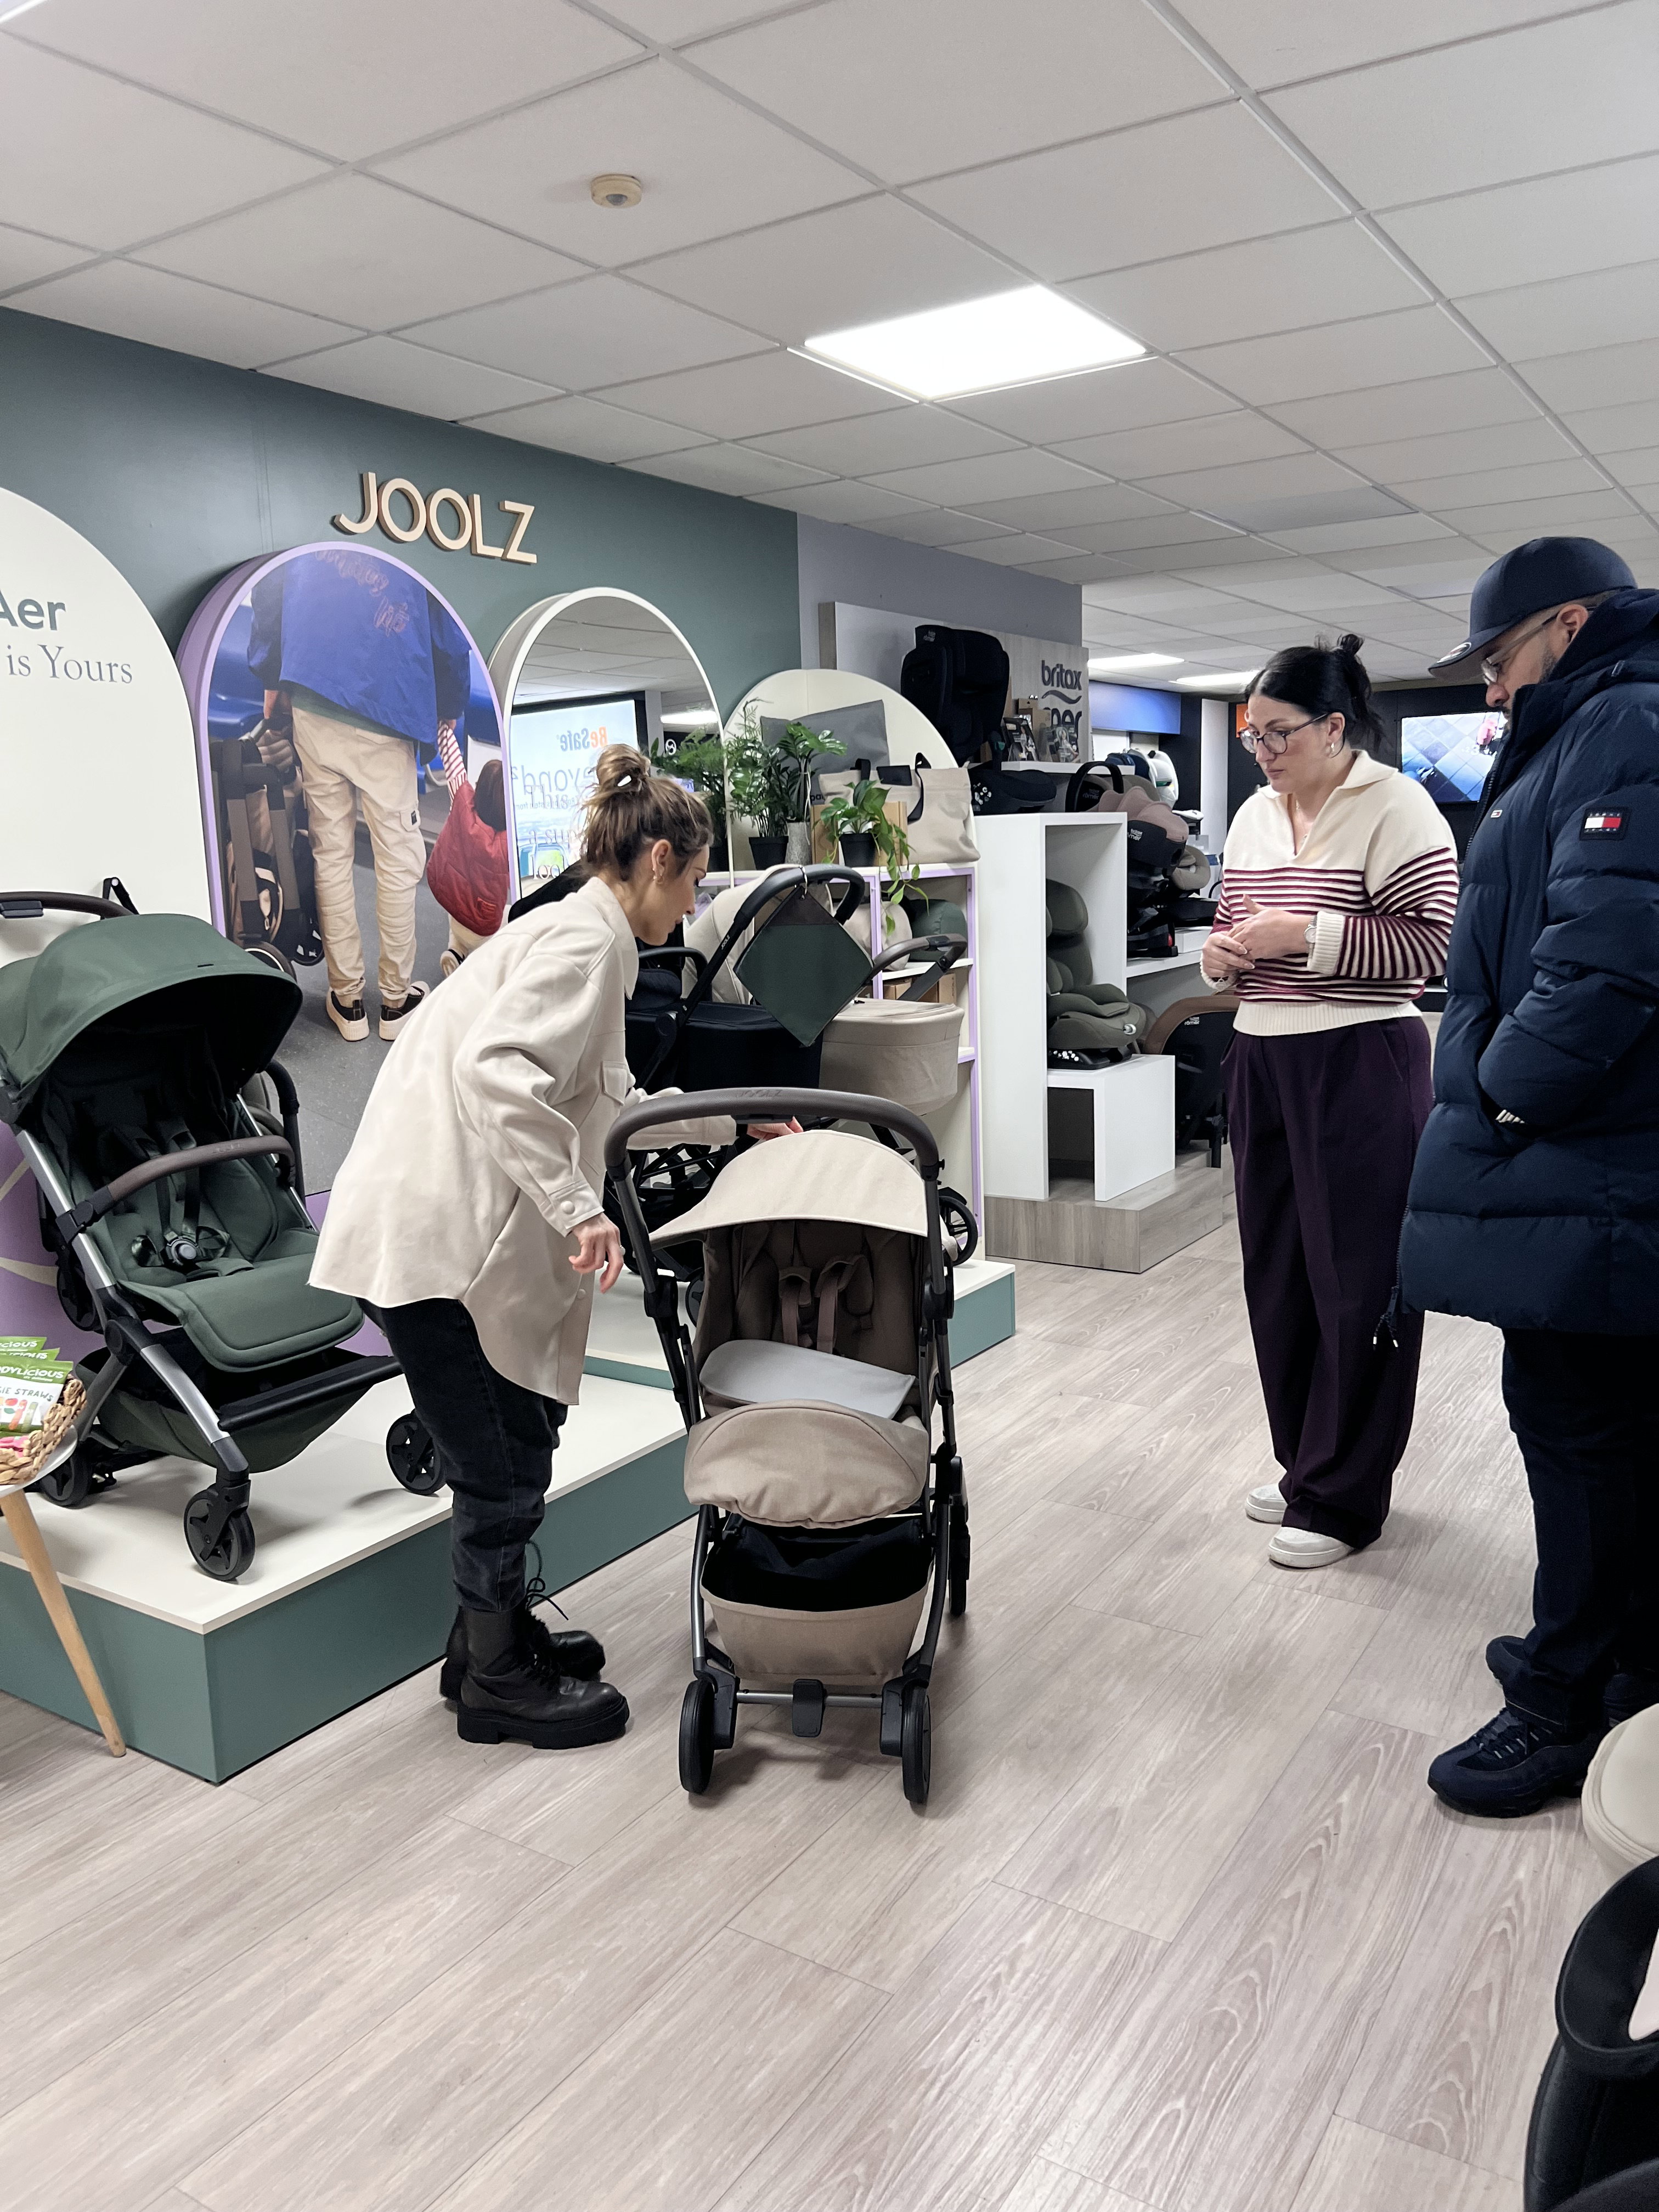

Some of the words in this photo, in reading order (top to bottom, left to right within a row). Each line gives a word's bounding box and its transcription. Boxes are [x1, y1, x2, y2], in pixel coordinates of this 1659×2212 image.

[332, 472, 537, 564] JOOLZ
[7, 645, 31, 676] is
[37, 644, 132, 684] Yours
[1042, 660, 1082, 690] britax
[15, 1389, 54, 1402] STRAWS
